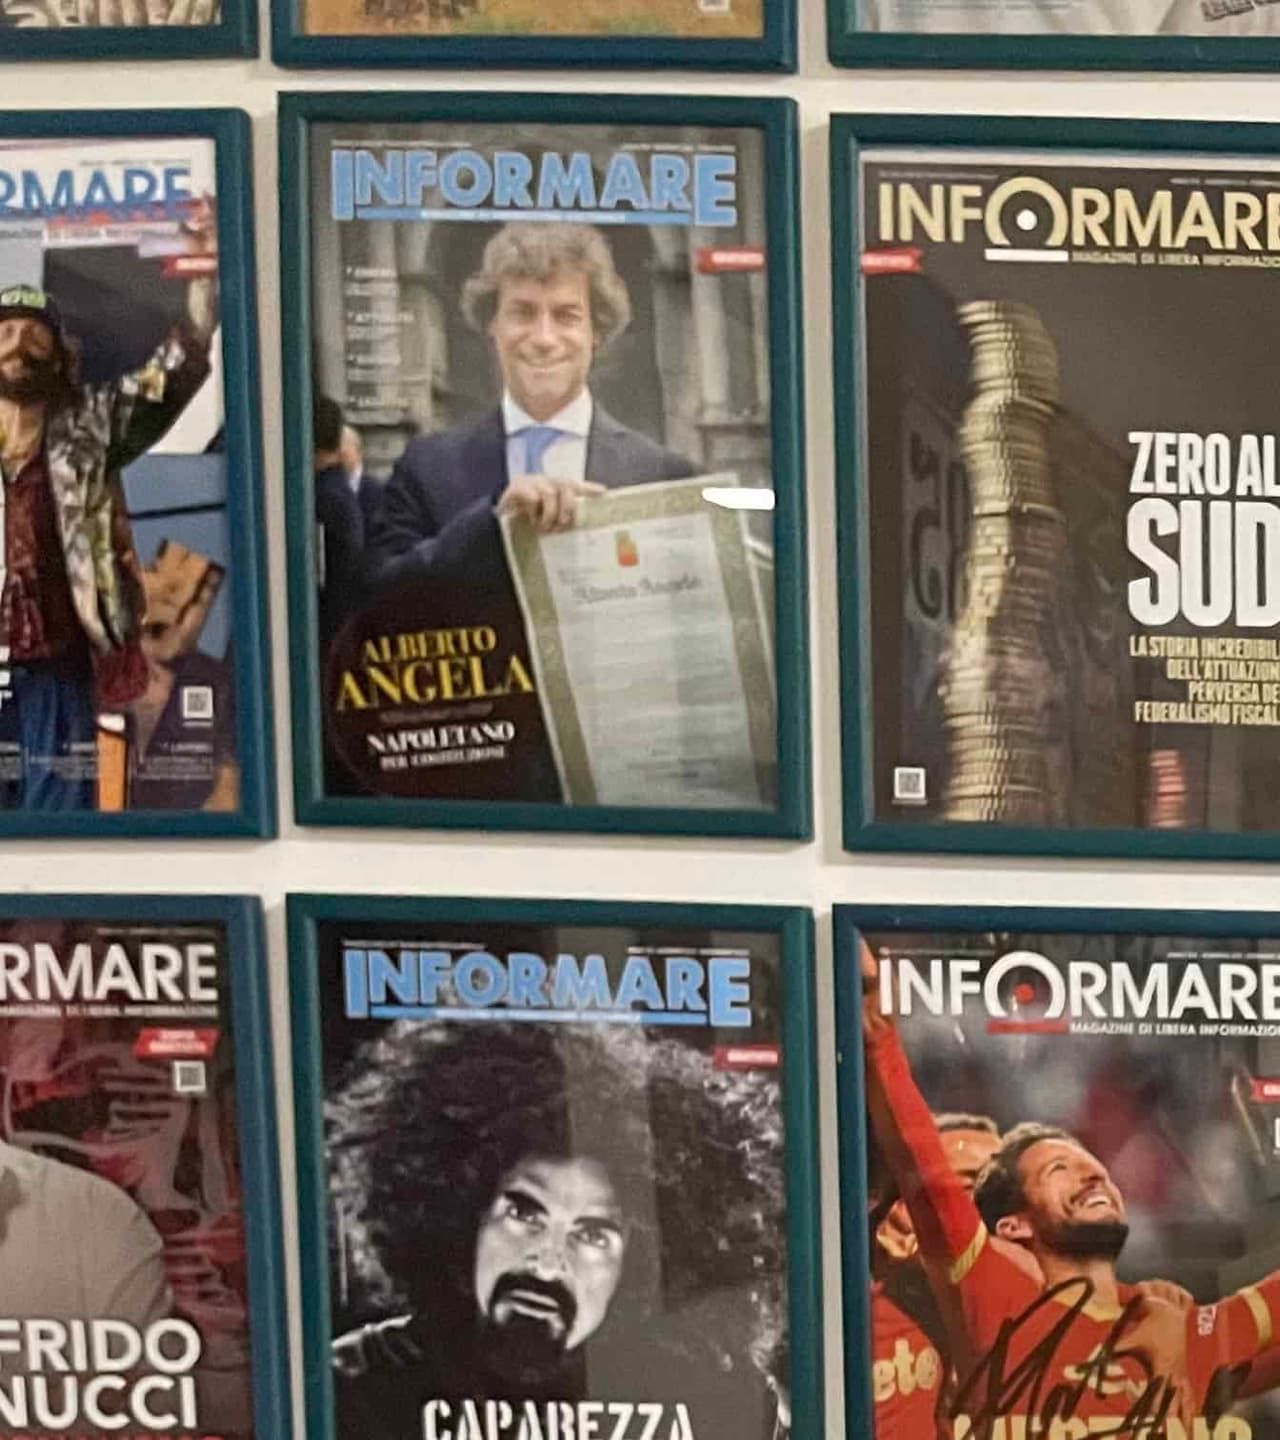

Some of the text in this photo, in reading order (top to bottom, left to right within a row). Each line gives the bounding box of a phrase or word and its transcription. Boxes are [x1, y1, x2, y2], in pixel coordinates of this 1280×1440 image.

[331, 150, 737, 227] INFORMARE
[1128, 432, 1231, 496] ZERO
[1130, 635, 1199, 658] LA STORIA
[336, 655, 535, 711] ANGELA
[1189, 681, 1260, 702] PERVERSA
[343, 949, 752, 1028] INFORMARE
[1069, 1022, 1135, 1036] MAGAZINE
[1138, 1023, 1153, 1036] DI
[1155, 1023, 1196, 1036] LIBERA
